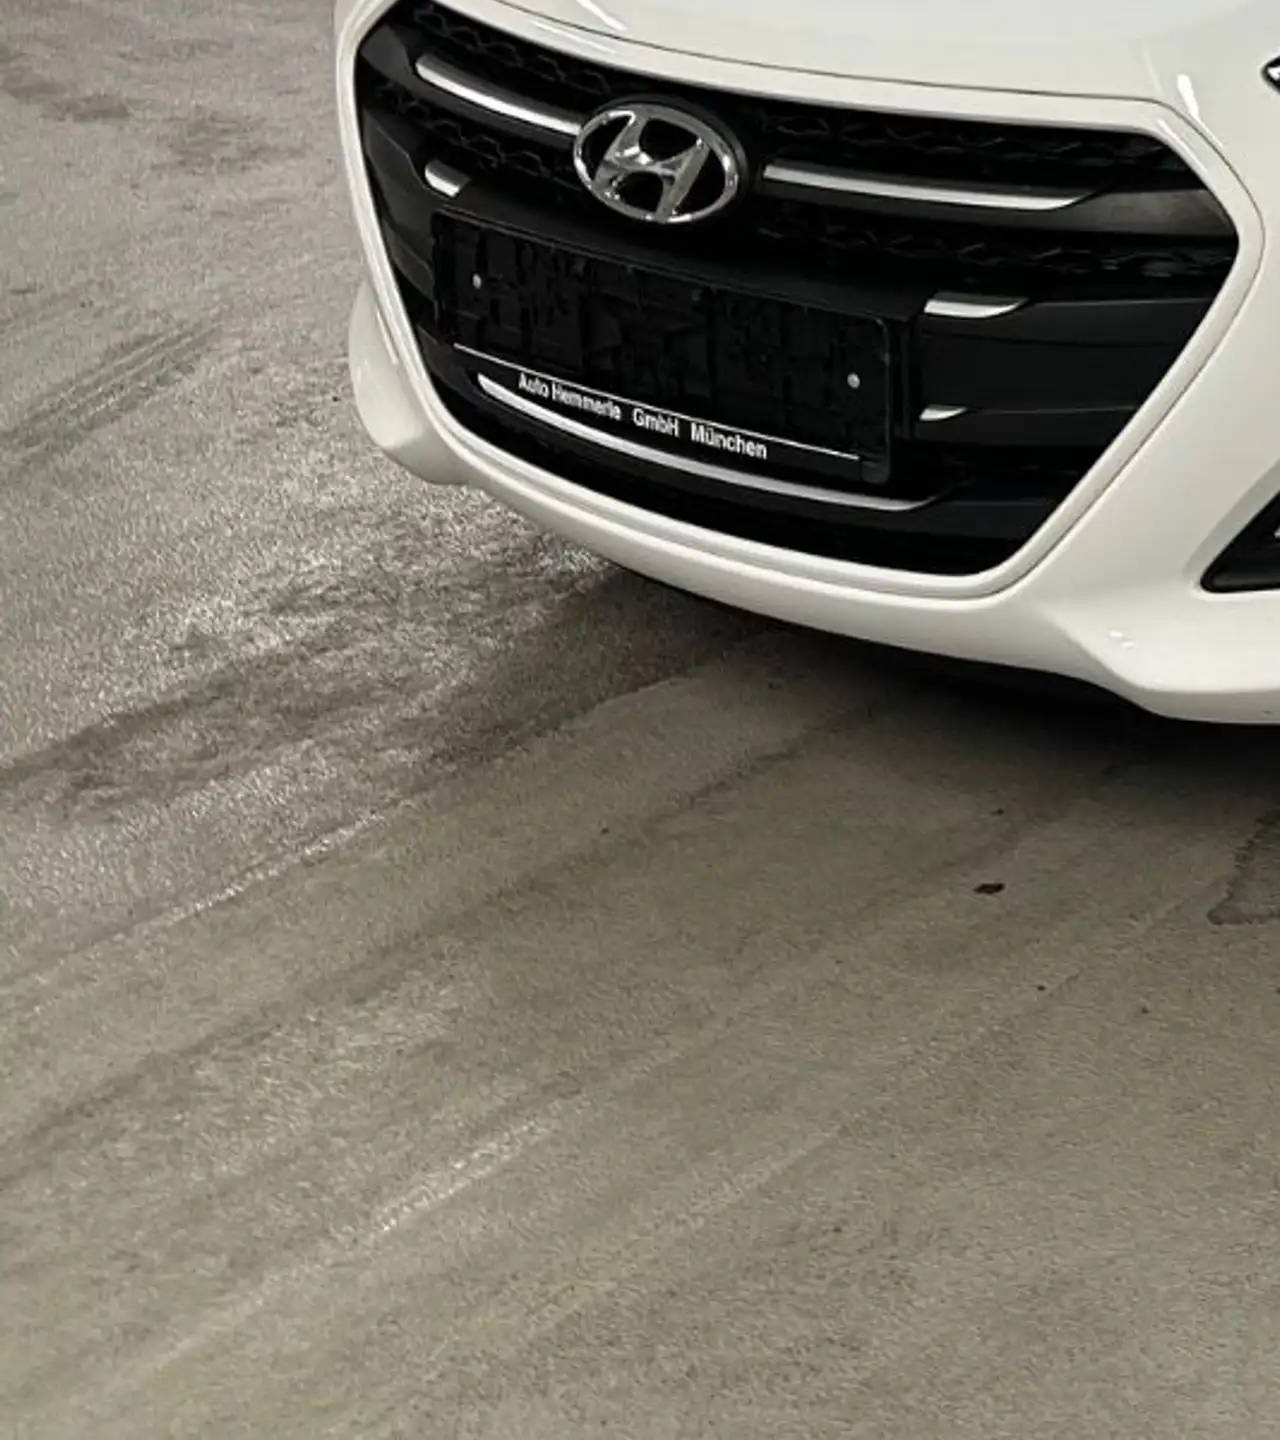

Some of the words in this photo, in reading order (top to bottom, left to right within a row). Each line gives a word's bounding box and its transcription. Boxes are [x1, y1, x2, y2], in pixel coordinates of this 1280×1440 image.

[518, 372, 549, 400] Auto
[552, 381, 621, 421] Hemmerle
[633, 408, 680, 438] GmbH
[691, 421, 768, 460] München
